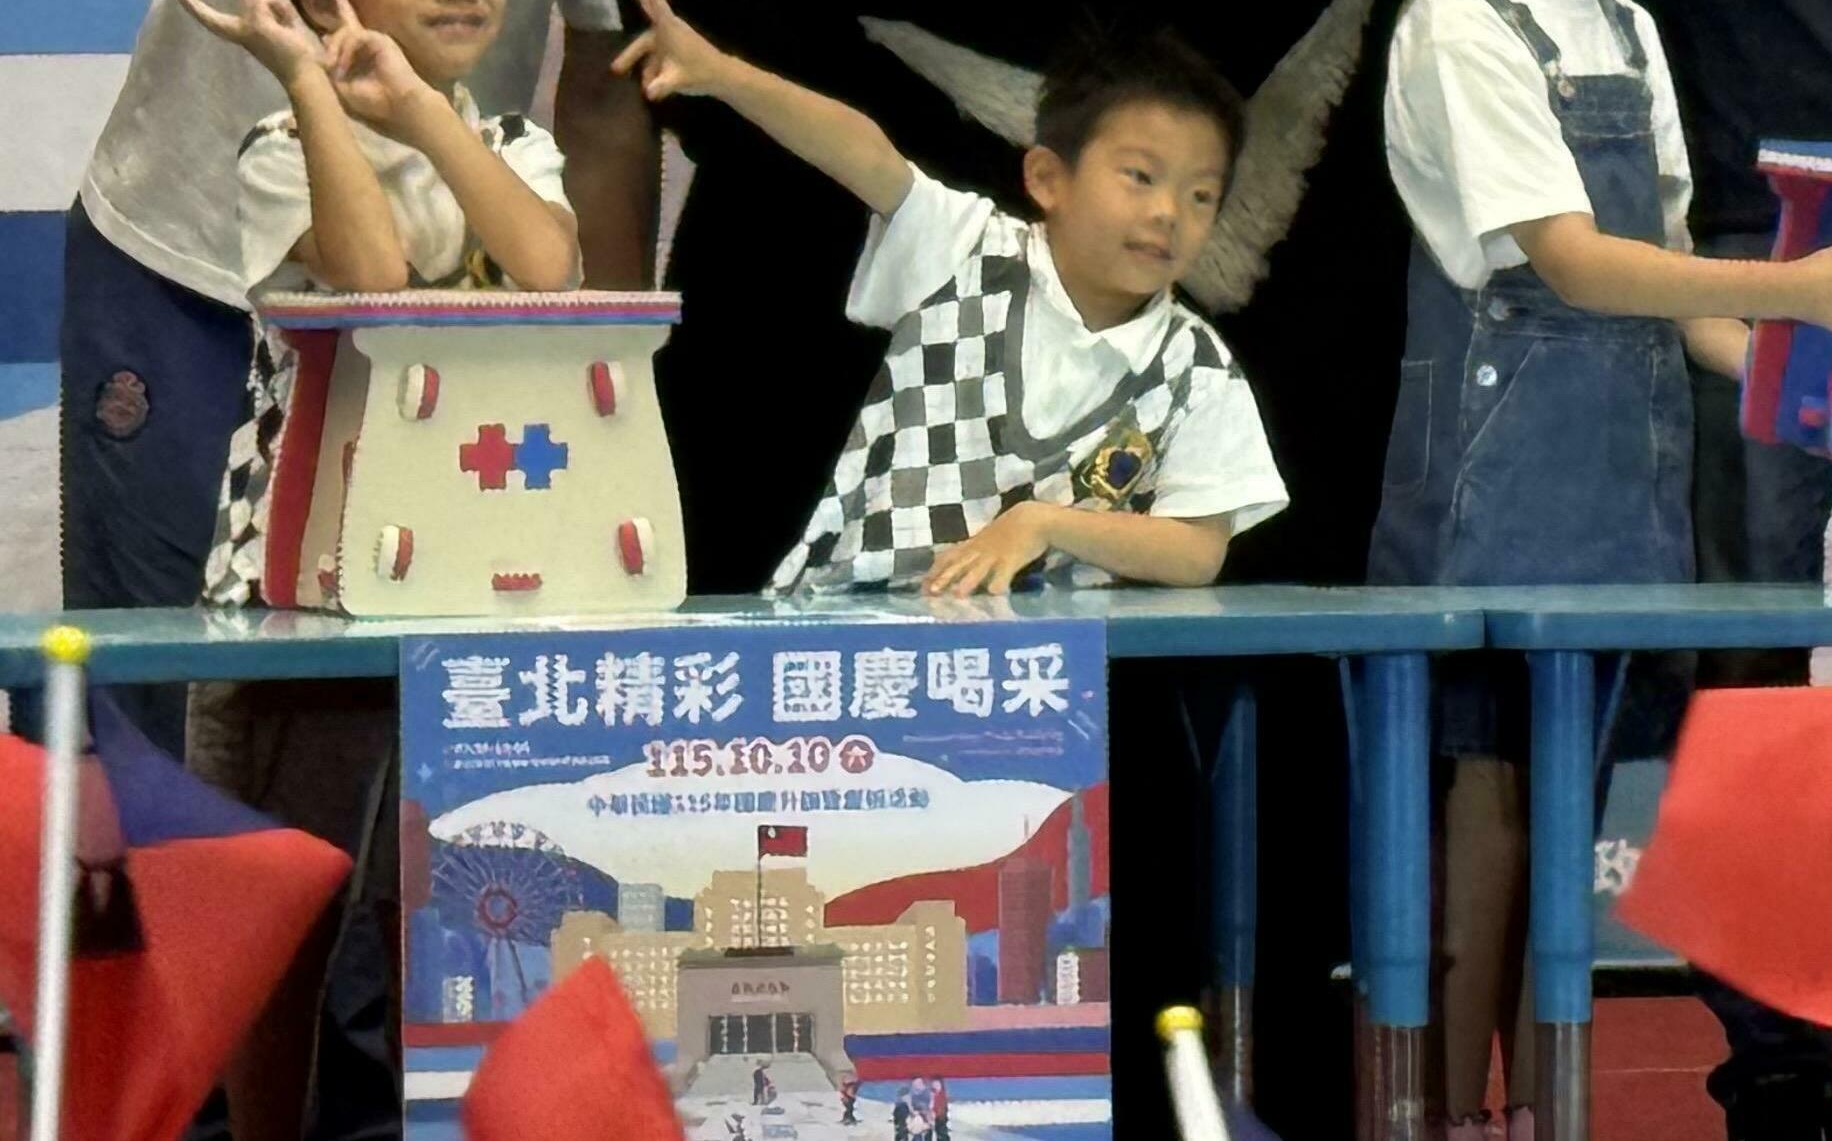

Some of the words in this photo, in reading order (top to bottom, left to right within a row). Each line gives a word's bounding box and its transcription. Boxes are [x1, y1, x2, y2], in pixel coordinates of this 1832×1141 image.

[441, 651, 743, 728] 臺北精彩
[772, 643, 1069, 722] 國慶喝采
